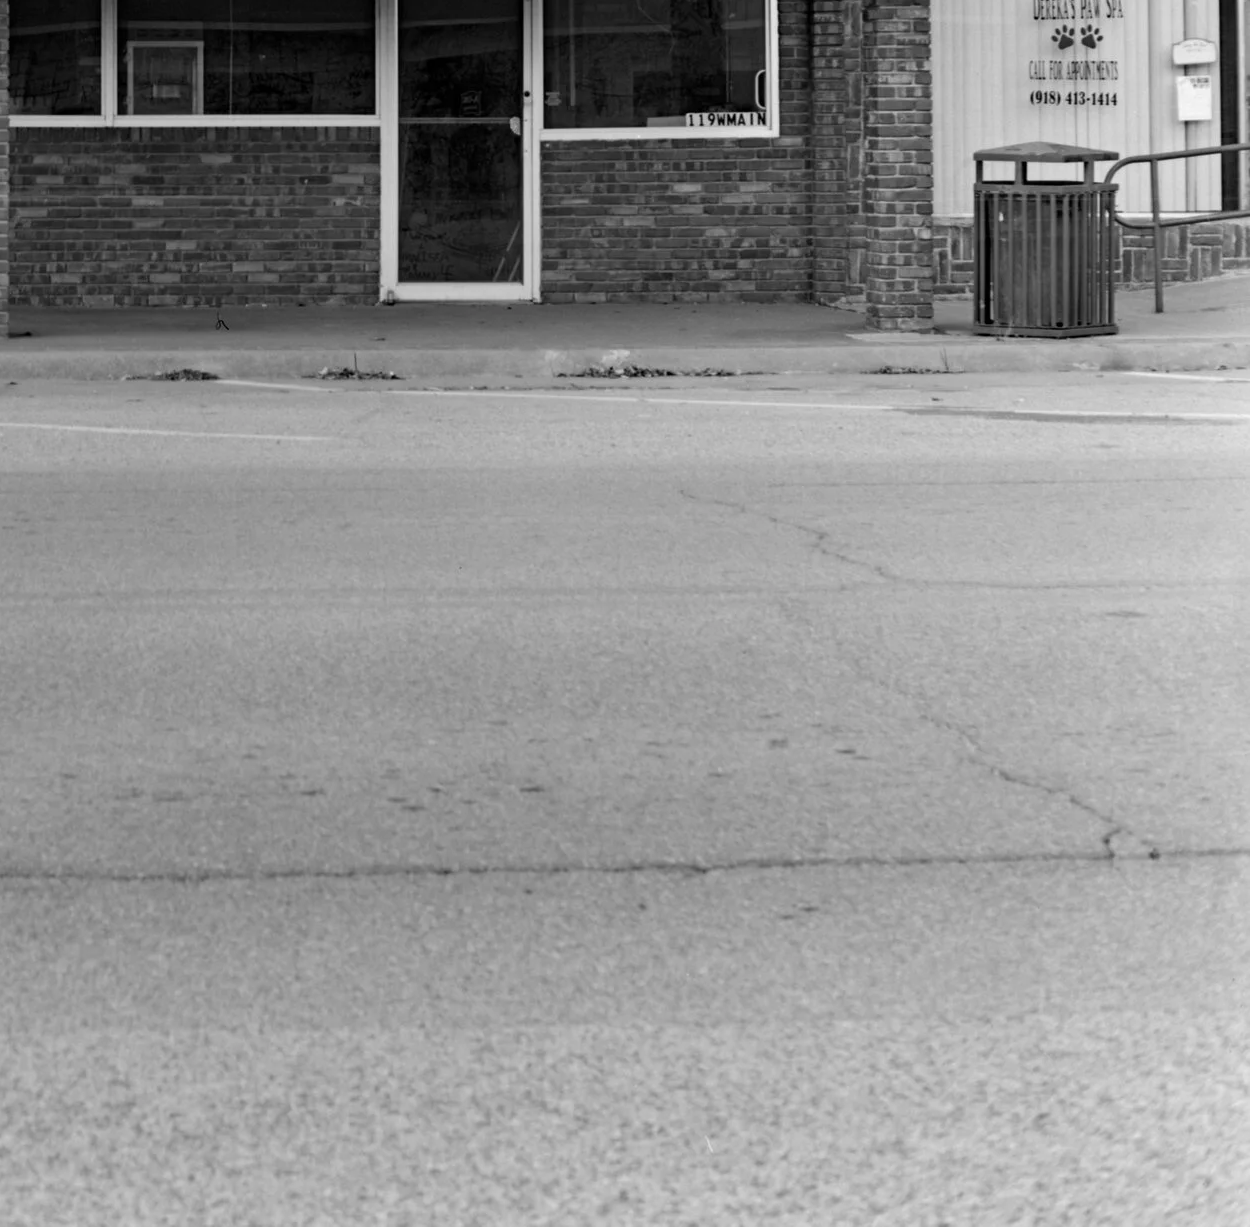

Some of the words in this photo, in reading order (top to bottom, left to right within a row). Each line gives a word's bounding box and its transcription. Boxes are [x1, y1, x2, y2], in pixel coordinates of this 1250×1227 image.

[1029, 60, 1046, 80] CALL
[1049, 60, 1063, 80] FOR
[1029, 90, 1061, 107] (918)
[1065, 91, 1118, 106] 413-1414
